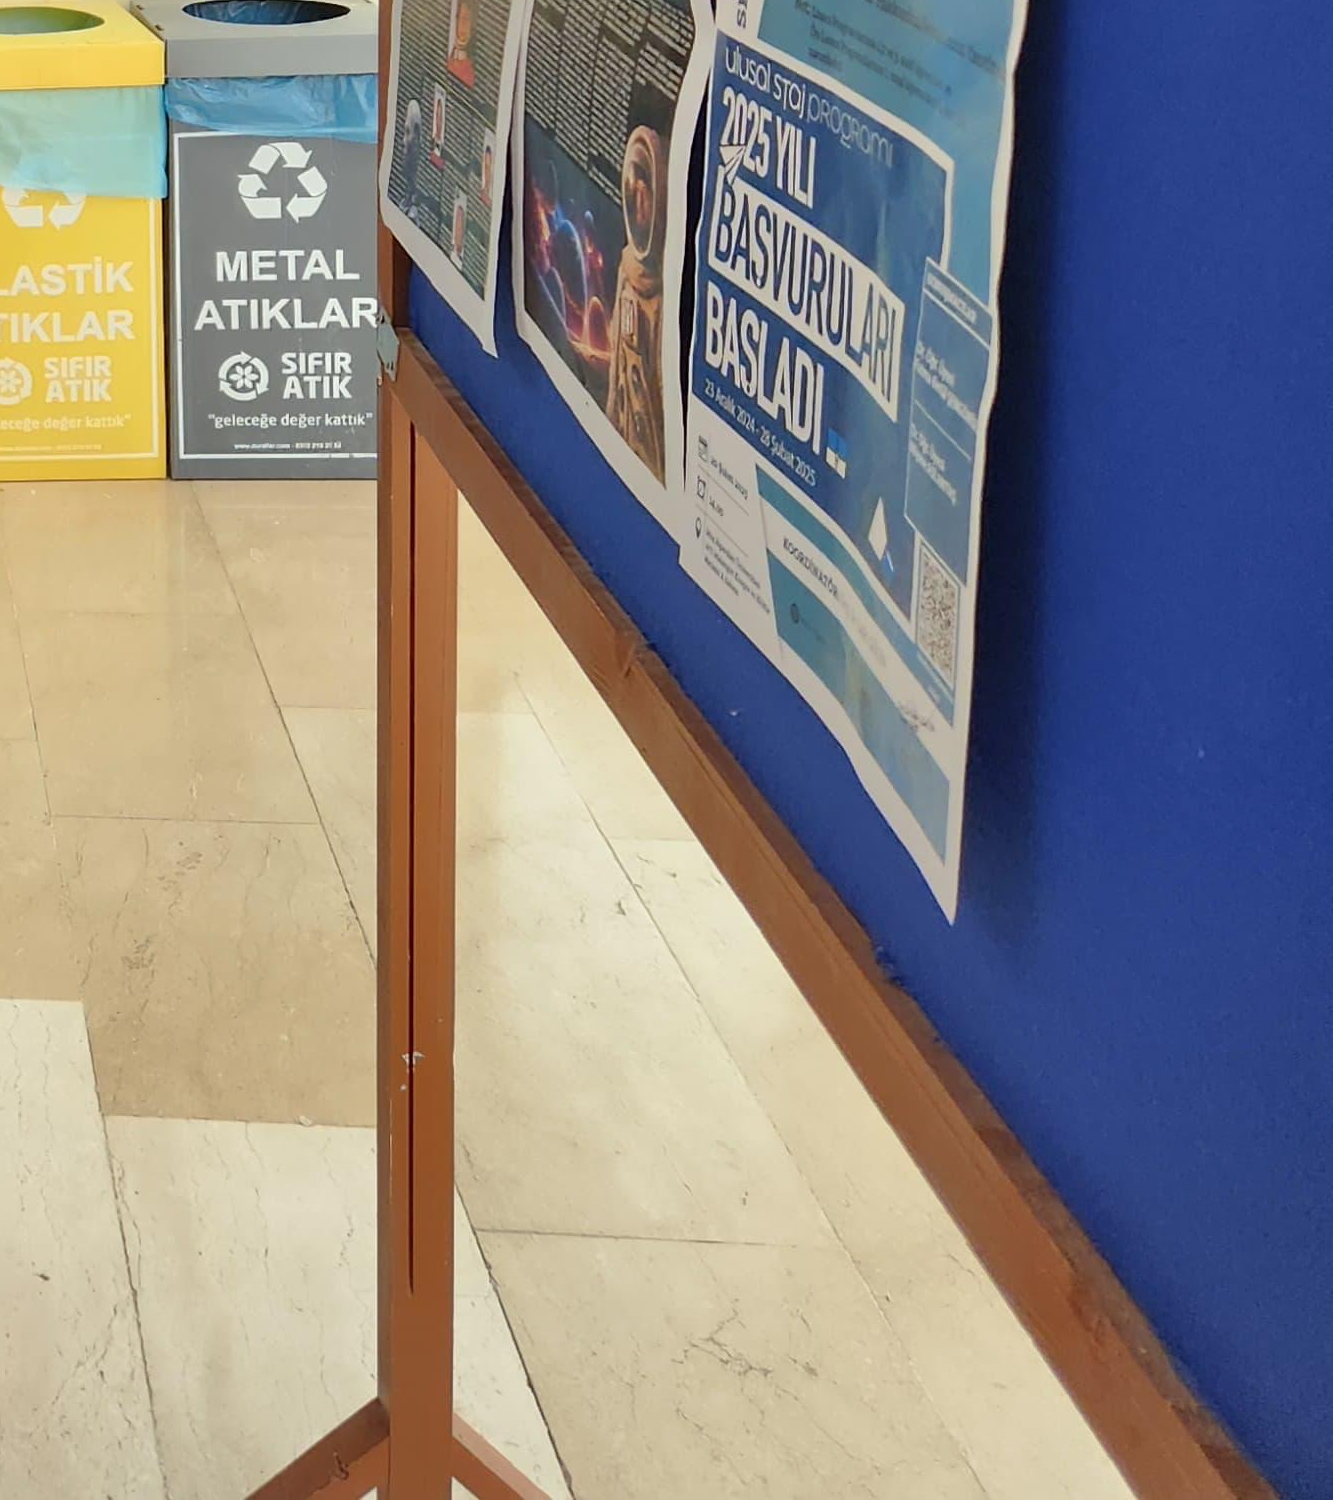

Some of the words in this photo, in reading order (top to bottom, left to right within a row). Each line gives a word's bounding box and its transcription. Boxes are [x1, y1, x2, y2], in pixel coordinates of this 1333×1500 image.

[720, 86, 773, 178] 2025
[774, 116, 818, 210] YILI
[215, 250, 360, 282] METAL
[194, 297, 378, 332] ATIKLAR
[44, 355, 112, 380] SIFIR
[281, 351, 353, 376] SIFIR
[704, 280, 824, 456] BAŞLADI
[45, 379, 112, 403] ATIK
[282, 374, 353, 400] ATIK
[43, 415, 83, 432] değer
[208, 413, 277, 429] "geleceğe
[281, 413, 321, 428] değer
[324, 412, 373, 427] kattık"
